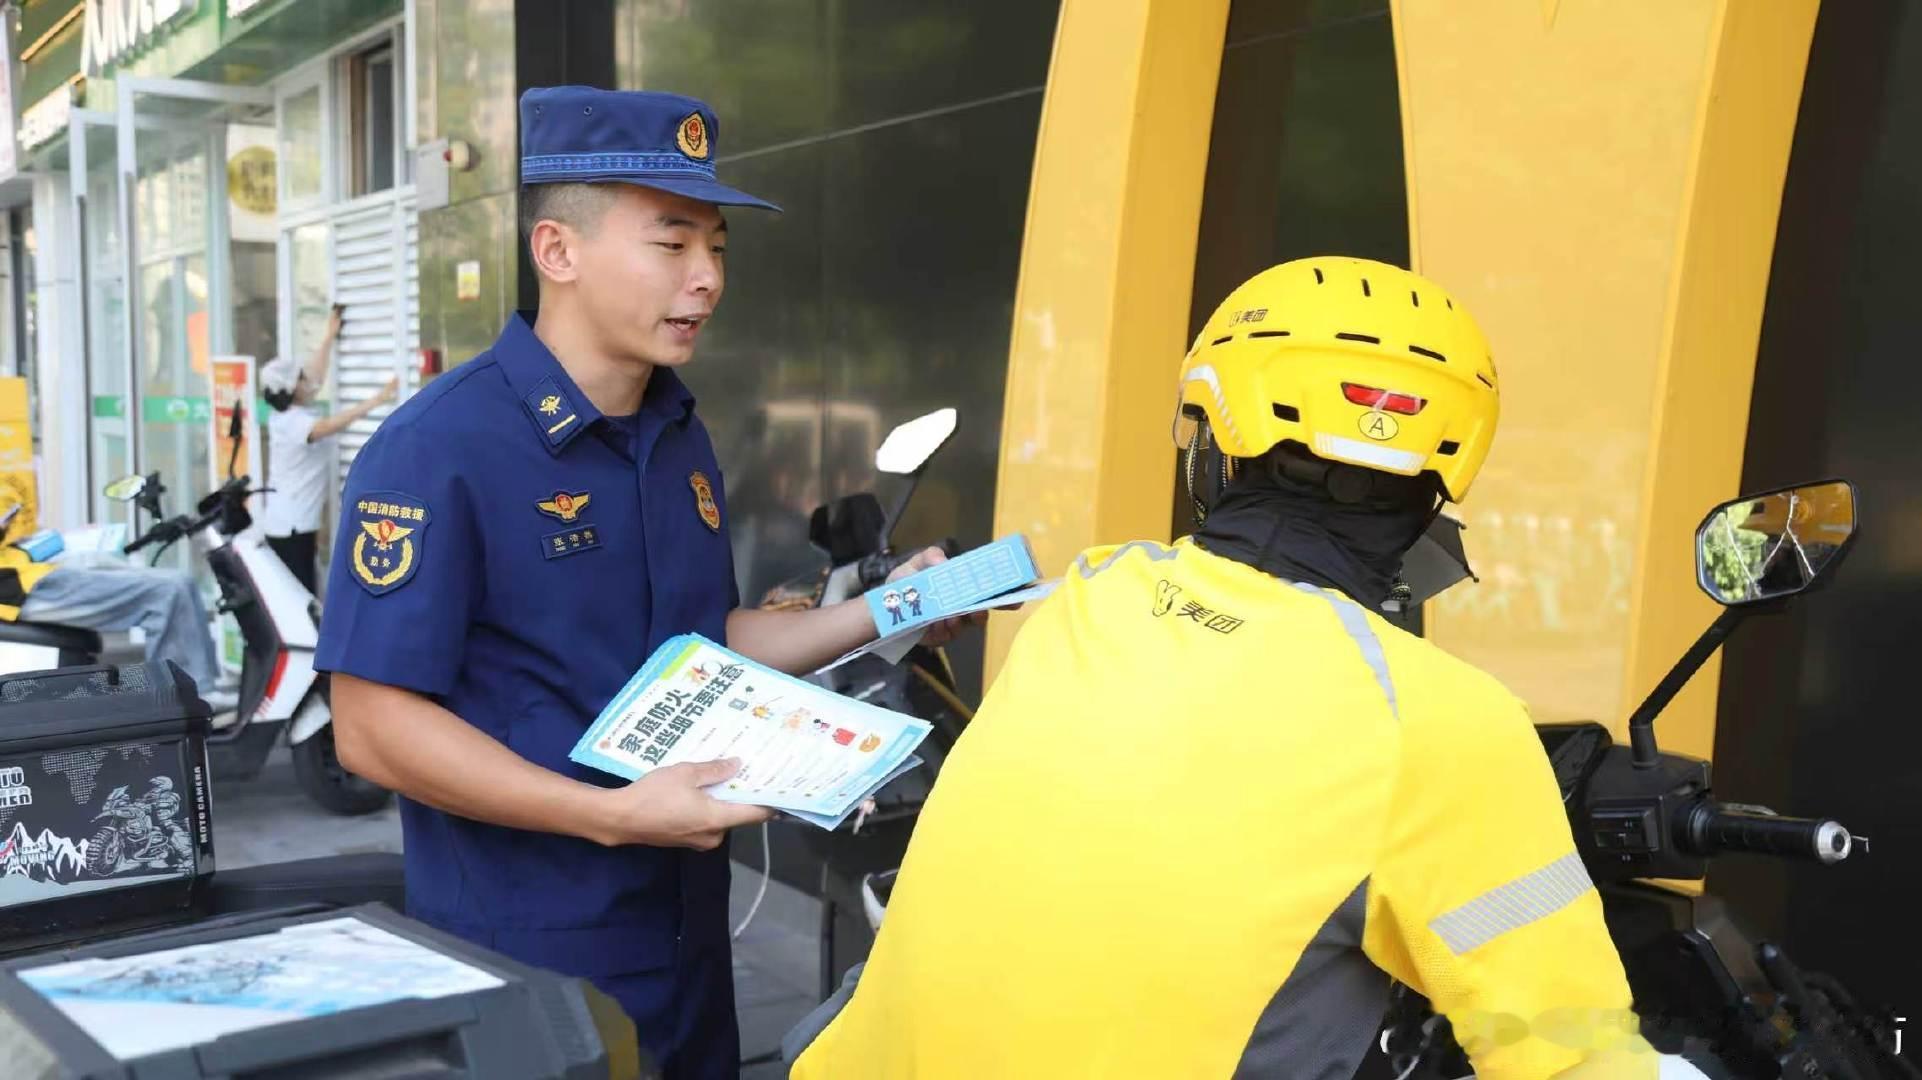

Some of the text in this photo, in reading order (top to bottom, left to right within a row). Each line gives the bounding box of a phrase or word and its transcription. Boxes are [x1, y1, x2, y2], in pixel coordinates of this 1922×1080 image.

[1241, 309, 1268, 323] 美团
[1368, 416, 1385, 437] A
[358, 500, 425, 521] 中国消防救援
[1176, 600, 1245, 635] 美团
[617, 689, 692, 754] 家庭防火
[640, 664, 745, 766] 这些细节要注意
[194, 766, 208, 844] MOTO CAMERA
